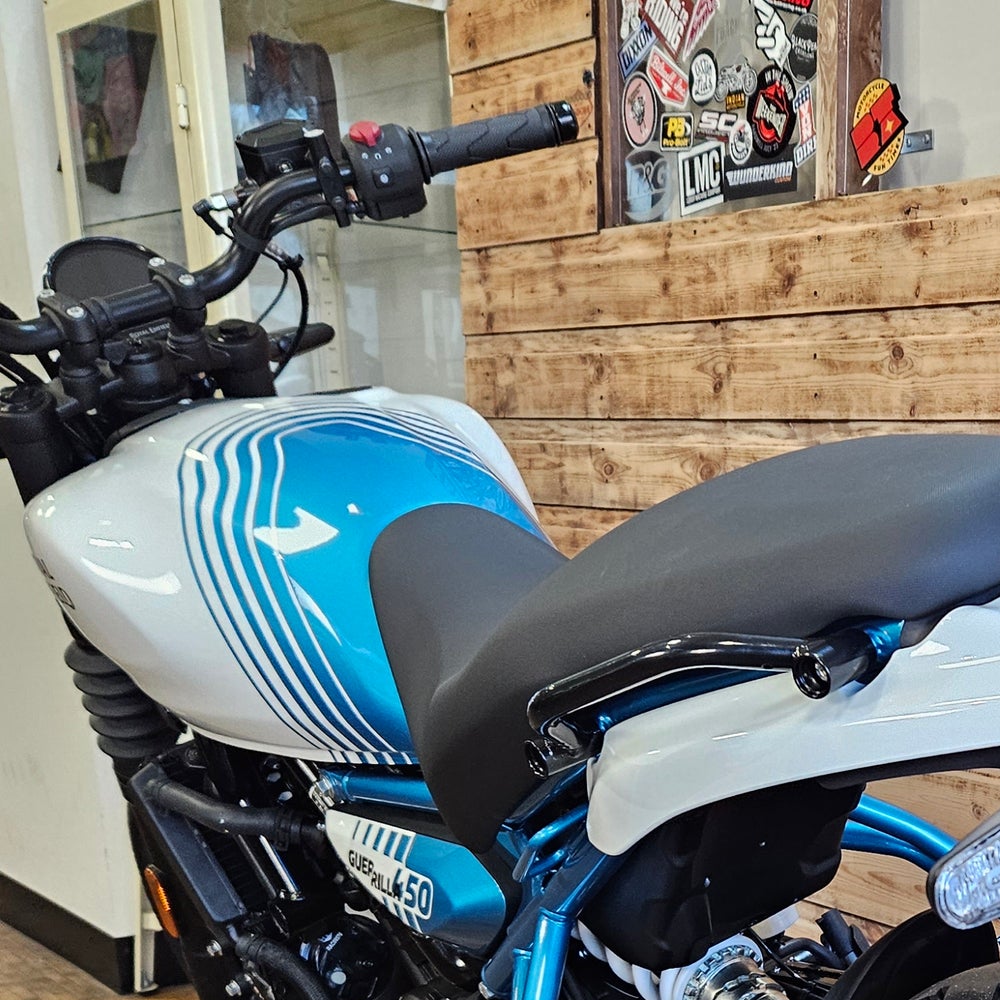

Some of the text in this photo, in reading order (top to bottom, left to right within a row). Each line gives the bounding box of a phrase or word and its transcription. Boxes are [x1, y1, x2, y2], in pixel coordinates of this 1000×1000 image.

[621, 24, 653, 71] DIXXON
[856, 82, 885, 119] MOTORCYCLE
[663, 138, 689, 148] Pro-Bolt
[667, 117, 687, 139] PB
[684, 149, 721, 198] LMC
[873, 163, 886, 172] FUN
[348, 849, 431, 916] GUERRILLA 450
